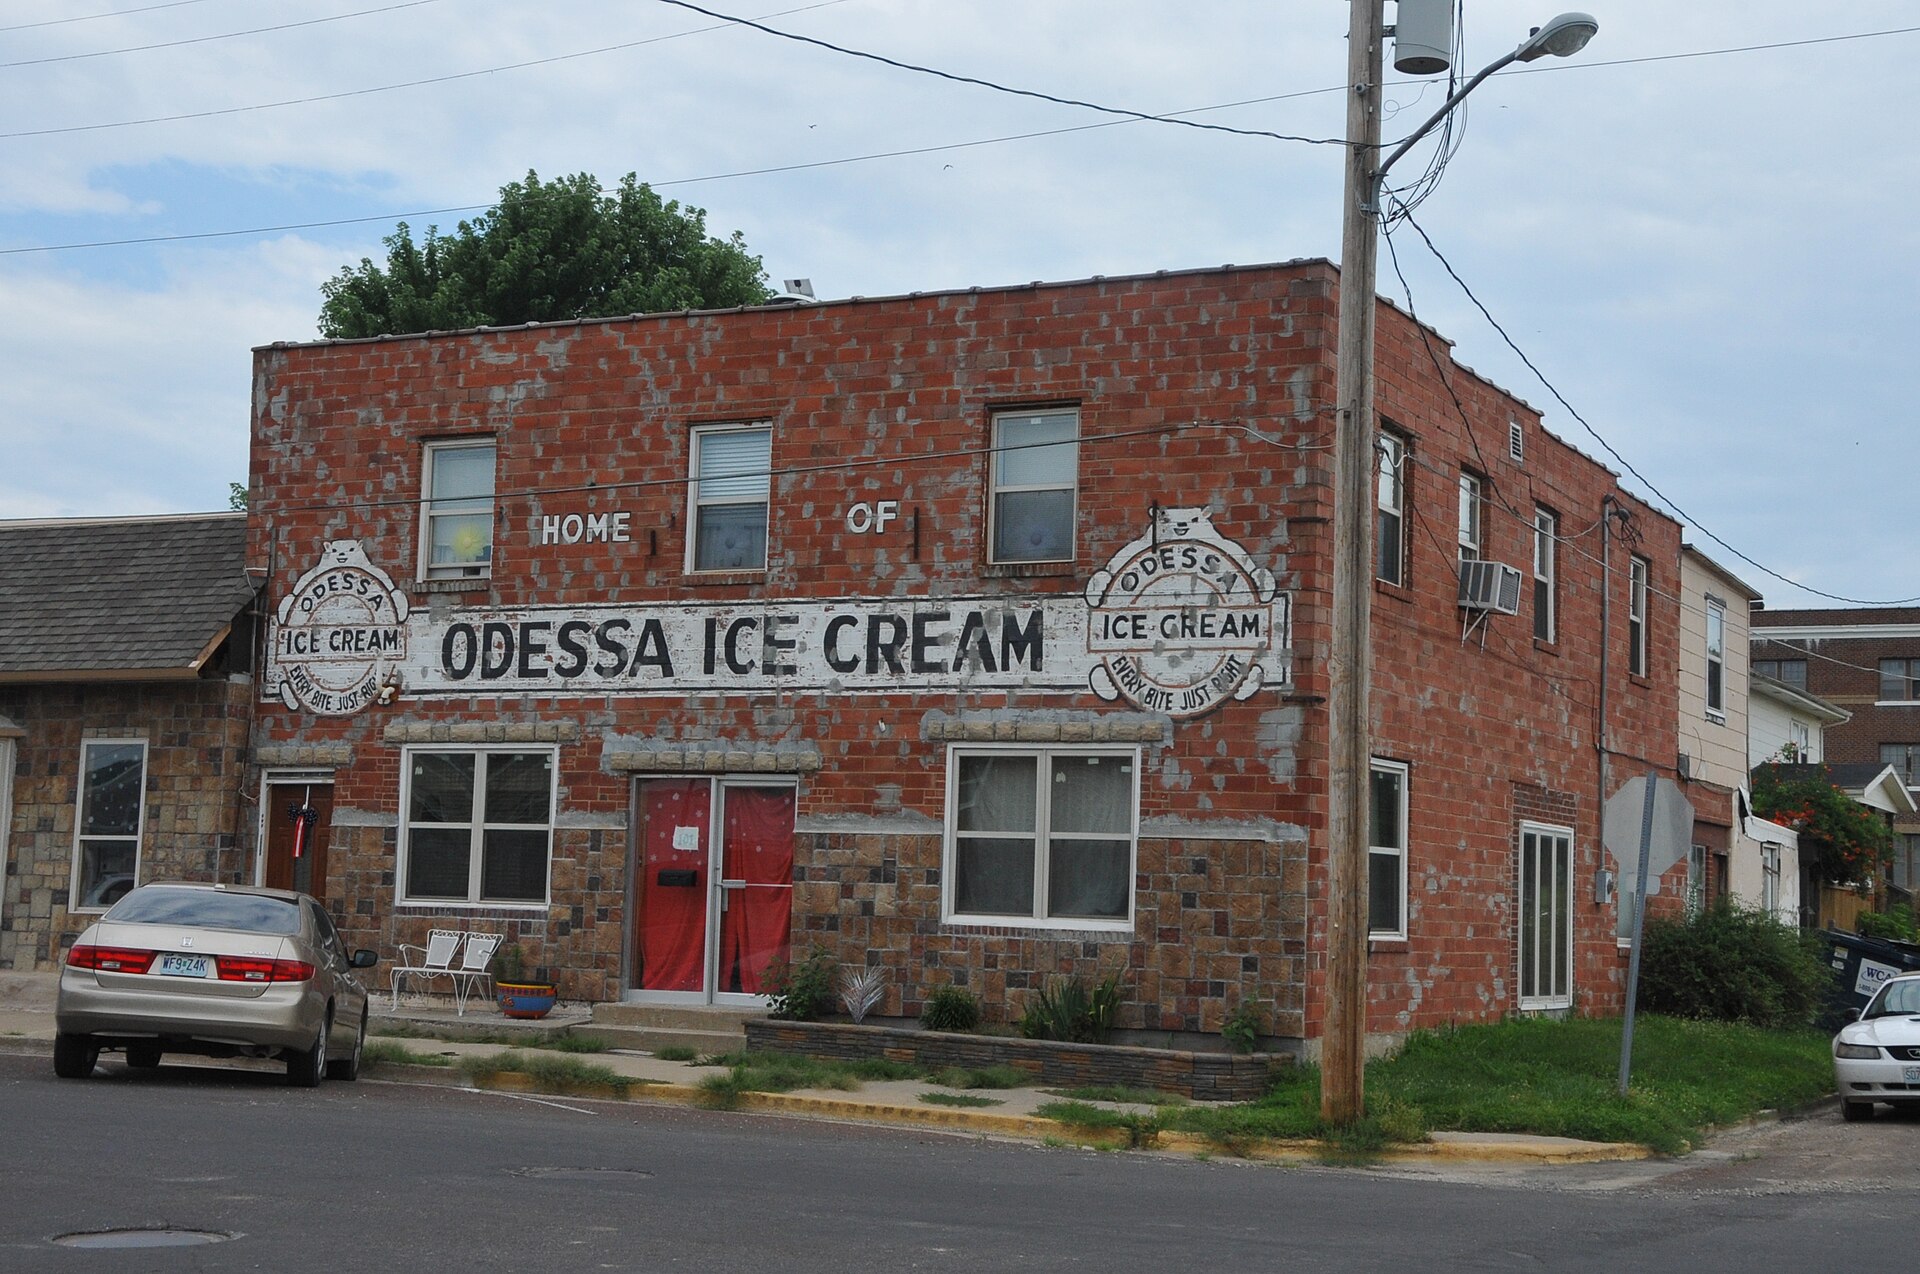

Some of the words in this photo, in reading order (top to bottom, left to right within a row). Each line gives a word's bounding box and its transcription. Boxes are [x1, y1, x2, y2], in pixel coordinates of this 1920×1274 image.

[541, 511, 632, 545] HOME
[846, 500, 898, 534] OF
[300, 572, 384, 612] ODESSA
[1121, 548, 1238, 594] ODESSA
[286, 630, 320, 654] ICE
[329, 629, 398, 652] CREAM
[441, 618, 675, 680] ODESSA
[703, 614, 799, 676] ICE
[823, 611, 1044, 674] CREAM
[1103, 614, 1147, 640] ICE
[1160, 613, 1260, 639] CREAM
[289, 665, 314, 696] EVERY
[311, 690, 332, 711] BITE
[337, 690, 359, 711] JUST
[361, 669, 384, 698] RIG
[1111, 655, 1147, 695] EVERY
[1144, 687, 1174, 711] BITE
[1180, 684, 1212, 711] JUST
[1866, 966, 1892, 982] WCA
